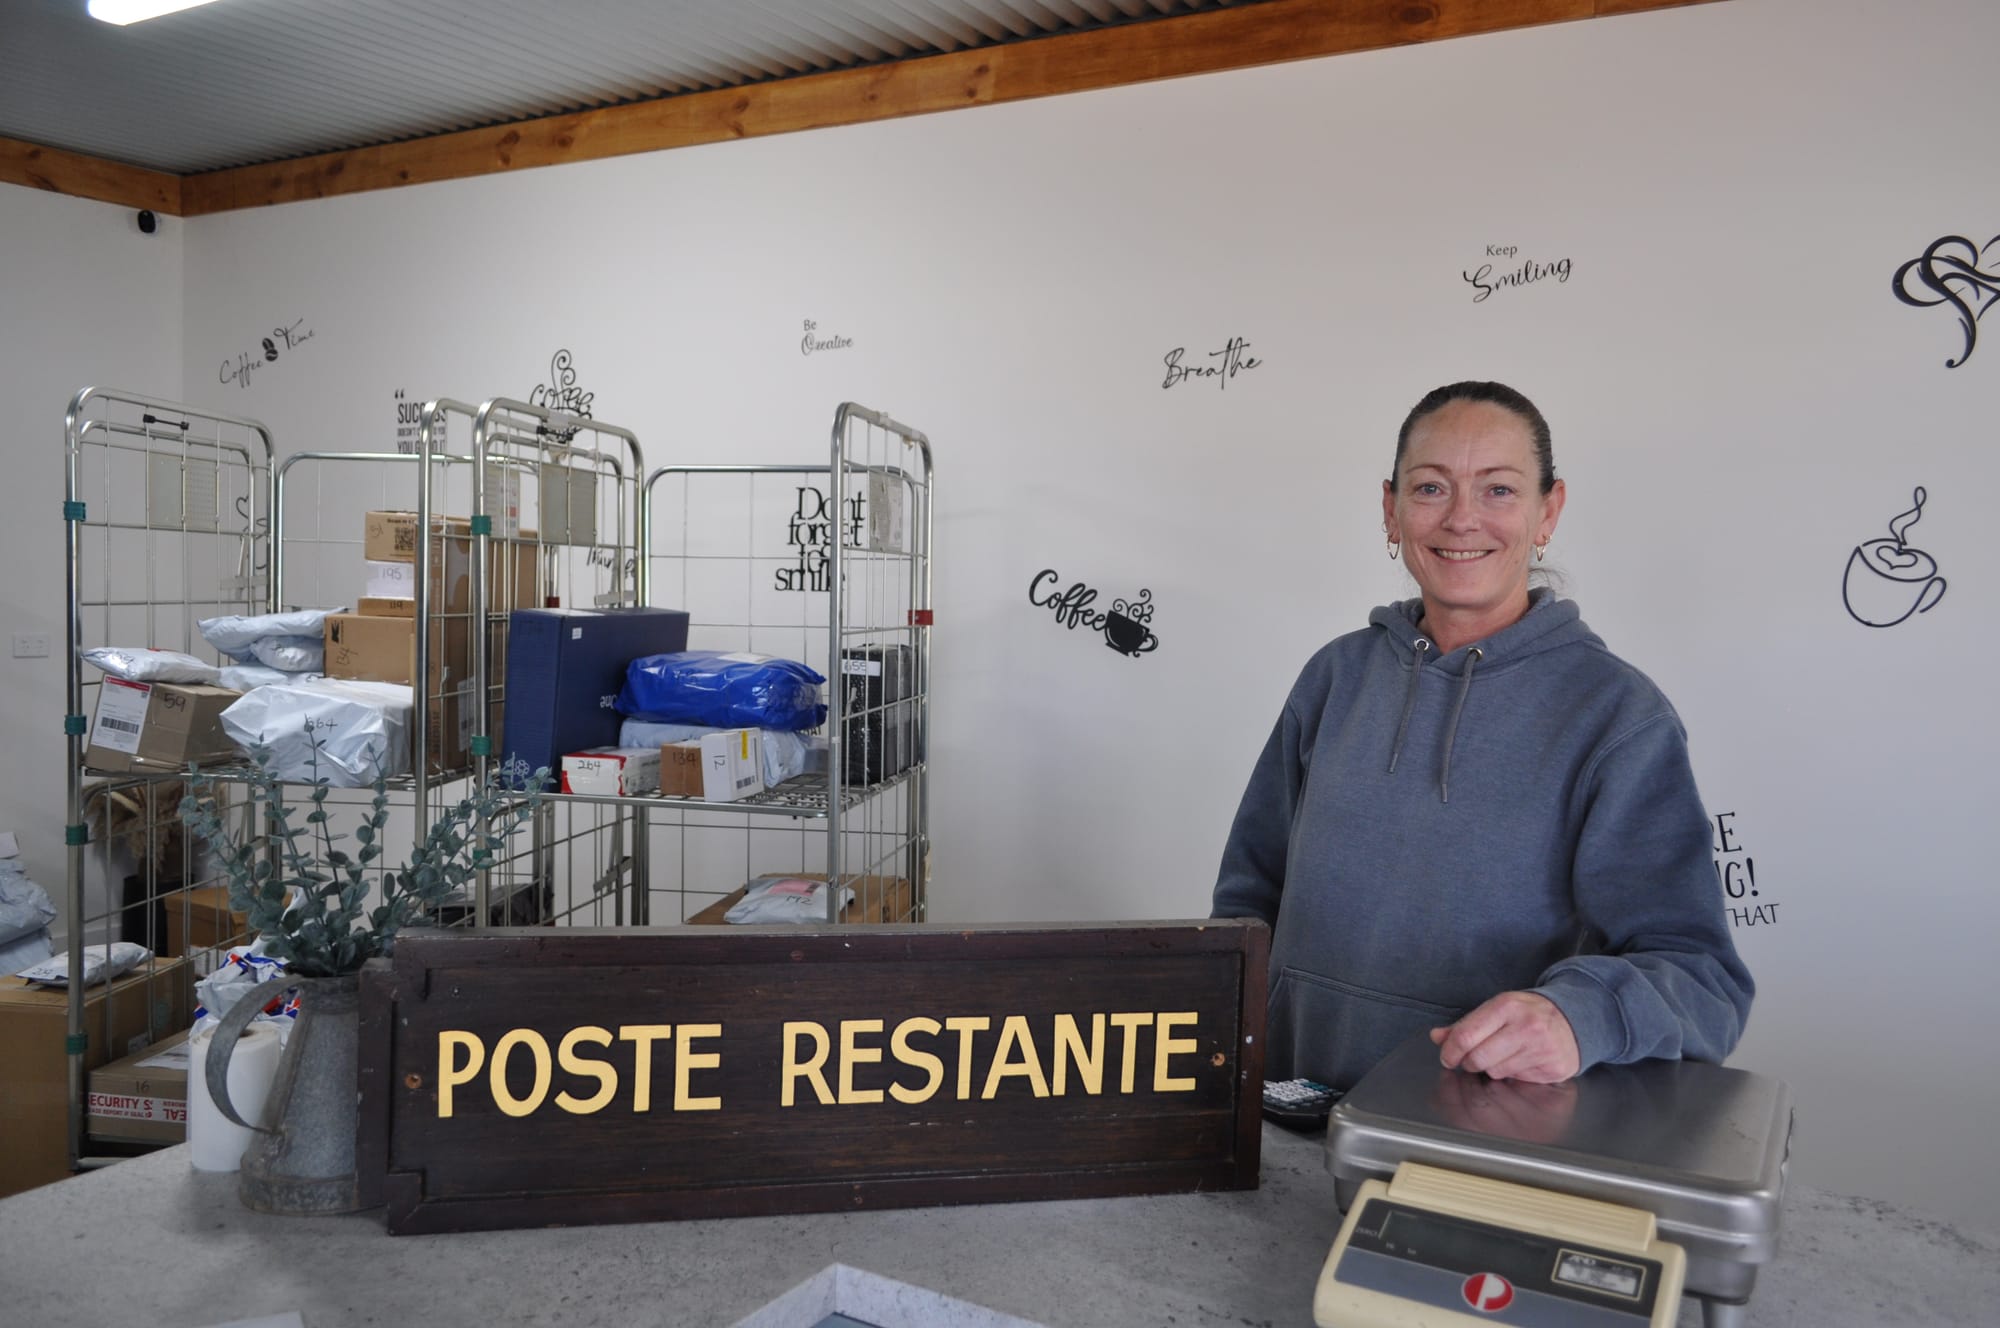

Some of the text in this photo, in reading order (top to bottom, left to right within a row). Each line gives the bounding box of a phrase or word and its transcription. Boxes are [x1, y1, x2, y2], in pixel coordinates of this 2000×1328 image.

[1486, 245, 1518, 258] Keep
[1463, 258, 1573, 303] Smiling
[801, 332, 854, 356] Creative
[803, 319, 817, 331] Be
[219, 317, 315, 389] Coffee Time
[1162, 336, 1262, 390] Breathe
[774, 560, 846, 592] smil
[1029, 568, 1106, 632] Coffee
[1710, 811, 1743, 853] E
[438, 1011, 1198, 1118] POSTE RESTANTE
[88, 1094, 140, 1110] ECURITY
